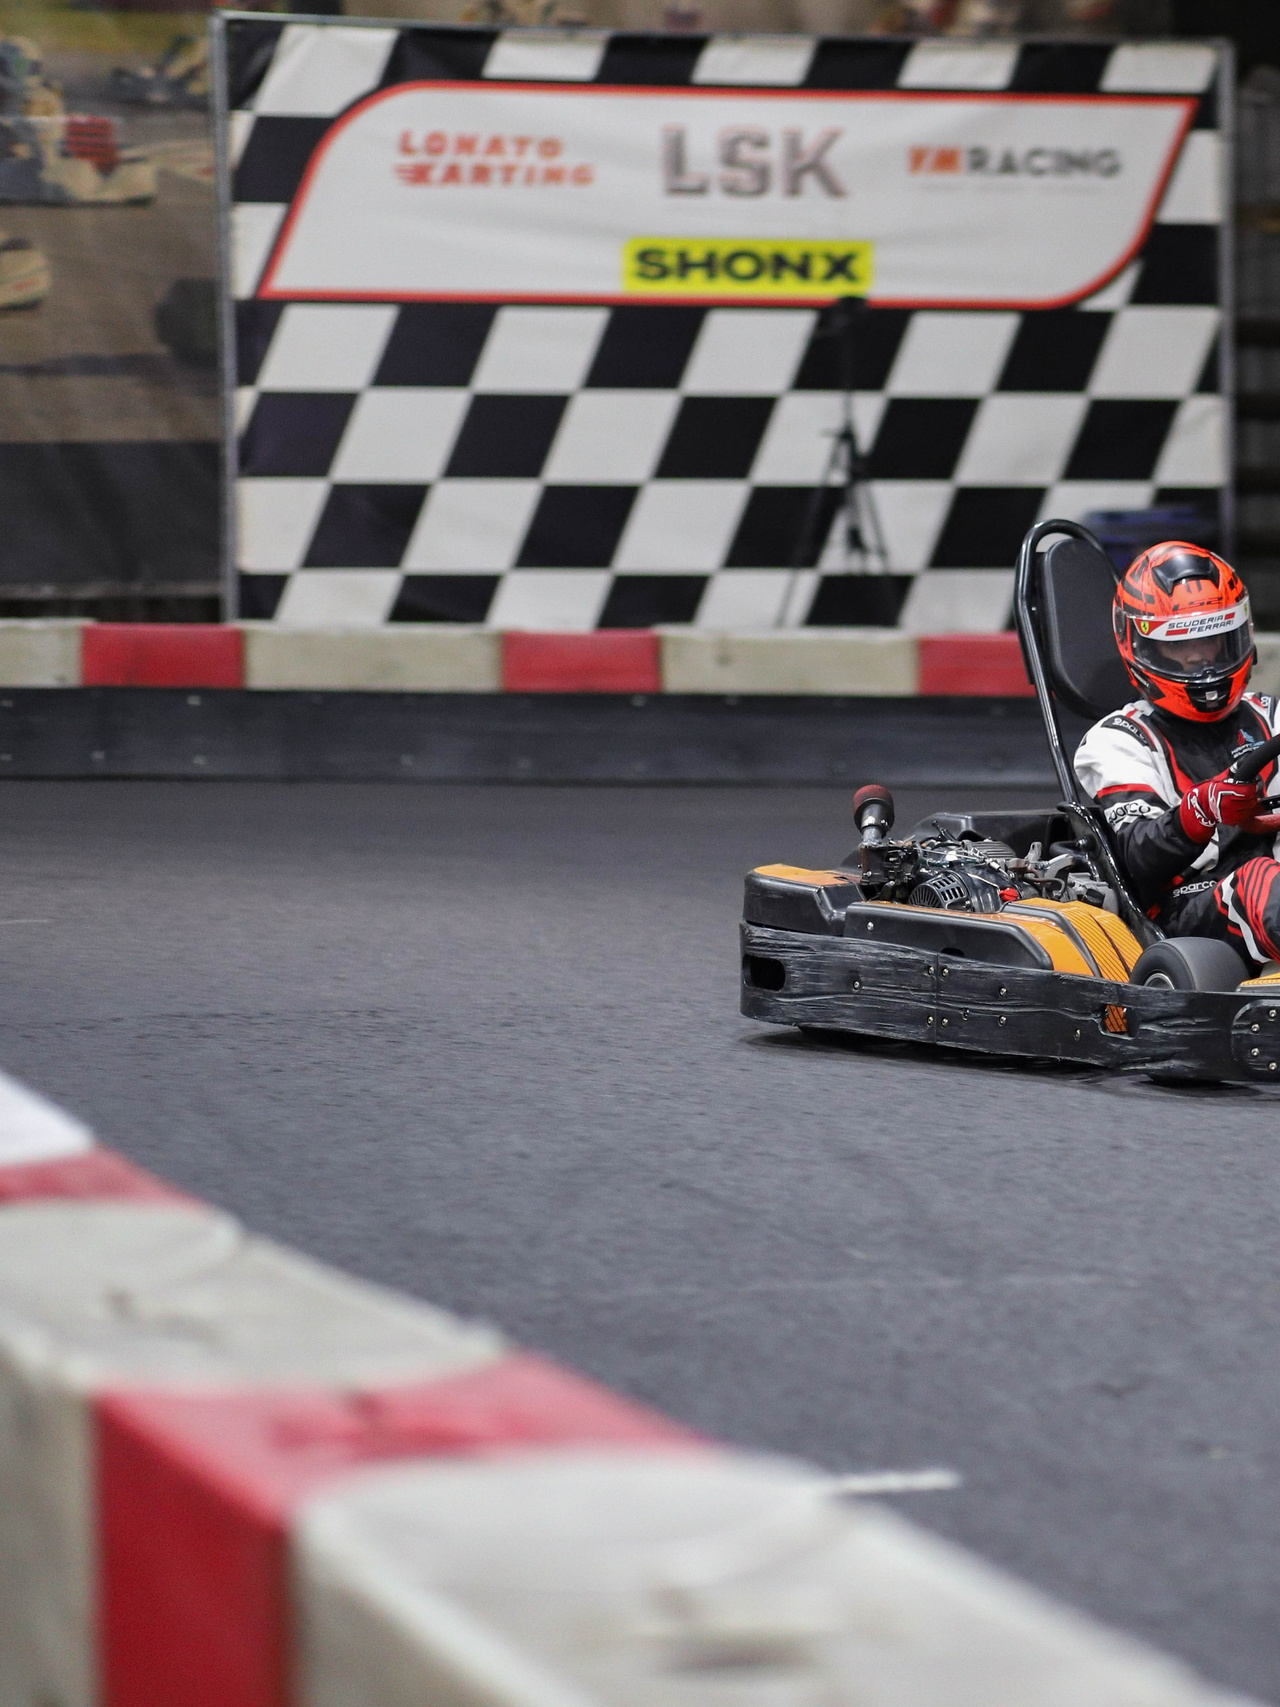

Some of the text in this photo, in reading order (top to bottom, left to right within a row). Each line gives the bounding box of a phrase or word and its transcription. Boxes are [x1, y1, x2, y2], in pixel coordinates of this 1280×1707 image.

[399, 129, 565, 160] LONATO
[661, 122, 848, 199] LSK
[395, 164, 596, 187] KARTING
[636, 248, 859, 283] SHONX
[1168, 615, 1223, 629] SCUDERIA
[1189, 620, 1233, 633] FERRARI
